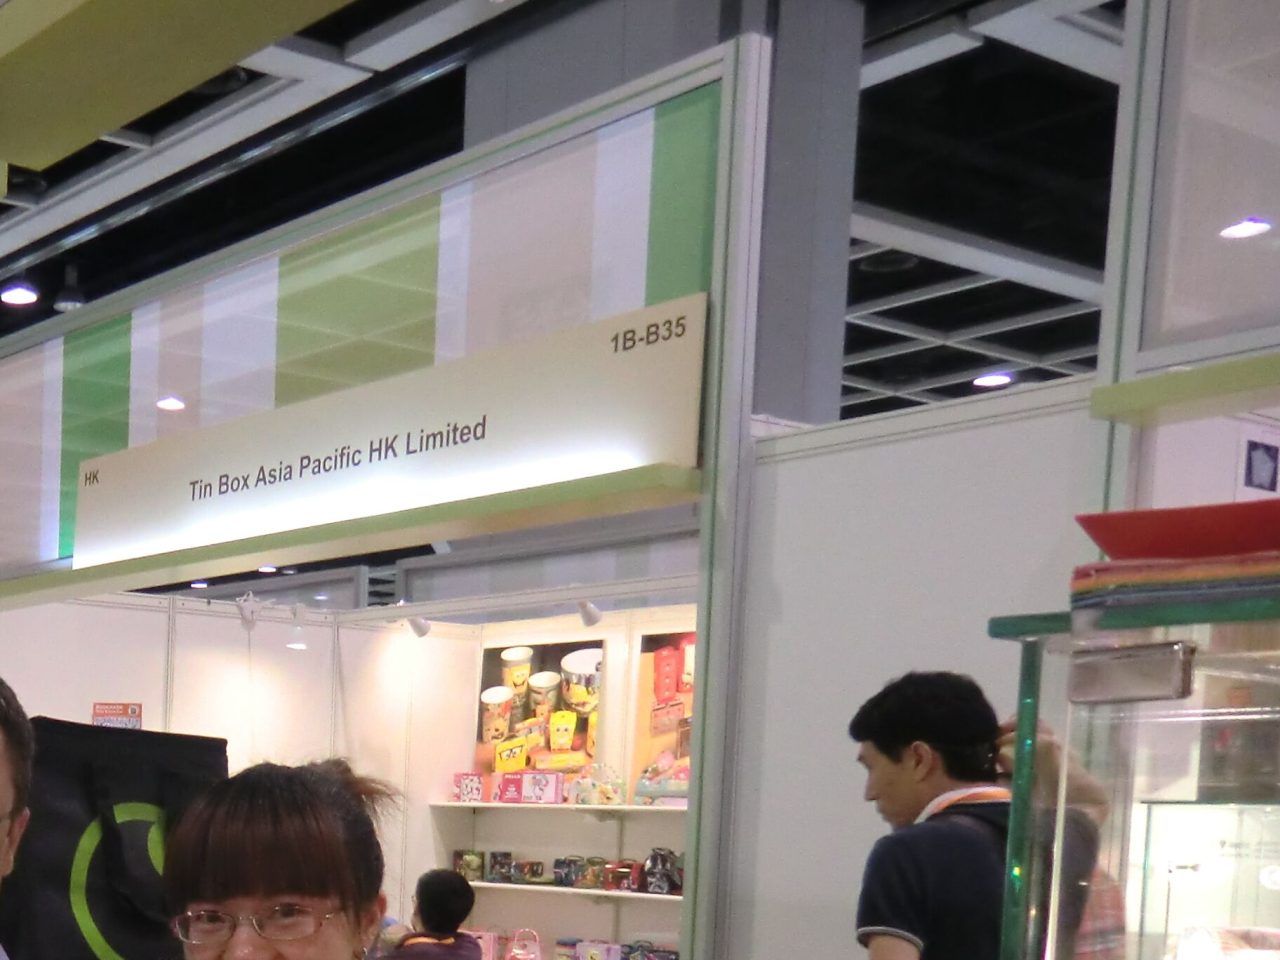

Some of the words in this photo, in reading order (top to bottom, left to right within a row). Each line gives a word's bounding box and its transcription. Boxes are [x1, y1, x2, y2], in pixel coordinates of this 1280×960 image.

[610, 315, 687, 352] 1B-B35
[189, 481, 213, 501] Tin
[218, 473, 250, 496] Box
[254, 461, 293, 488] Asia
[300, 446, 362, 479] Pacific
[369, 435, 400, 464] HK
[405, 414, 487, 455] Limited
[84, 470, 100, 487] HK
